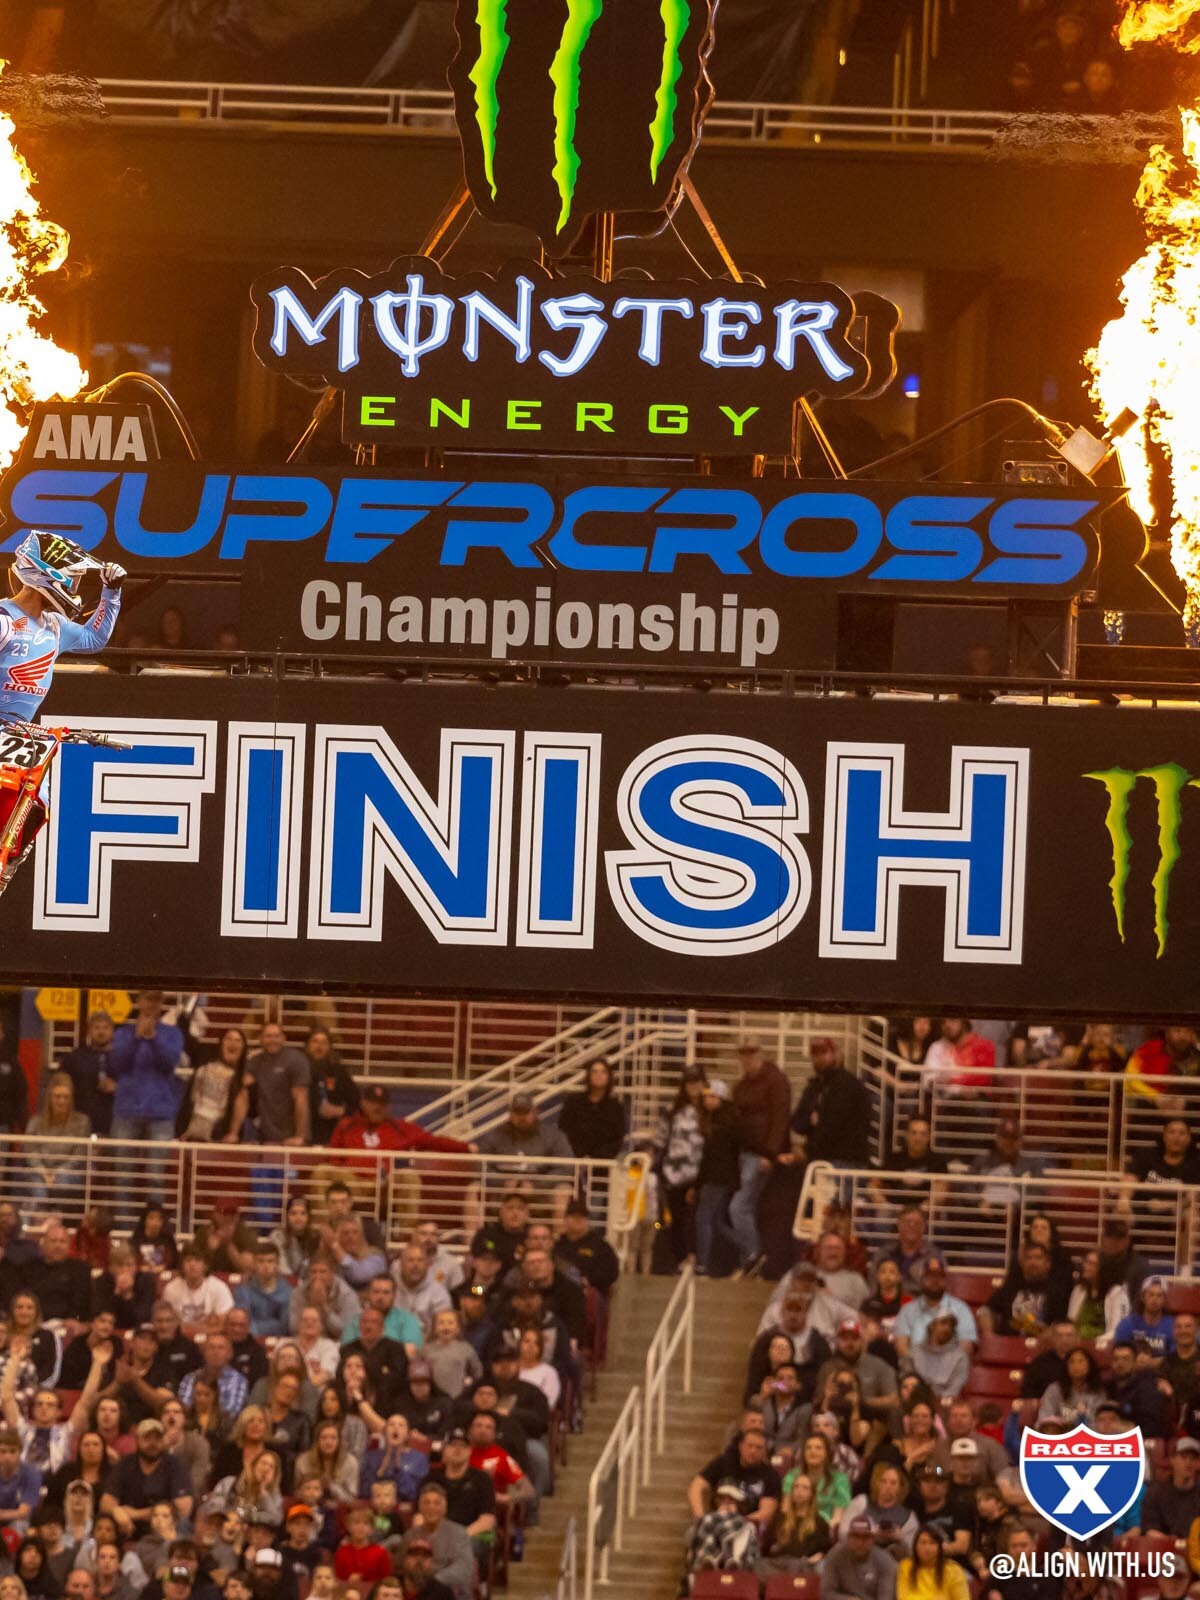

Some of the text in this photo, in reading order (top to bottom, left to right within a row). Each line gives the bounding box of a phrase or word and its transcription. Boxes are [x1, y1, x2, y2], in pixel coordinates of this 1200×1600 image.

[269, 274, 854, 382] MONSTER
[33, 414, 148, 462] AMA
[360, 396, 759, 436] ENERGY
[10, 642, 29, 657] 23
[300, 580, 780, 667] Championship
[33, 714, 1030, 965] FINISH
